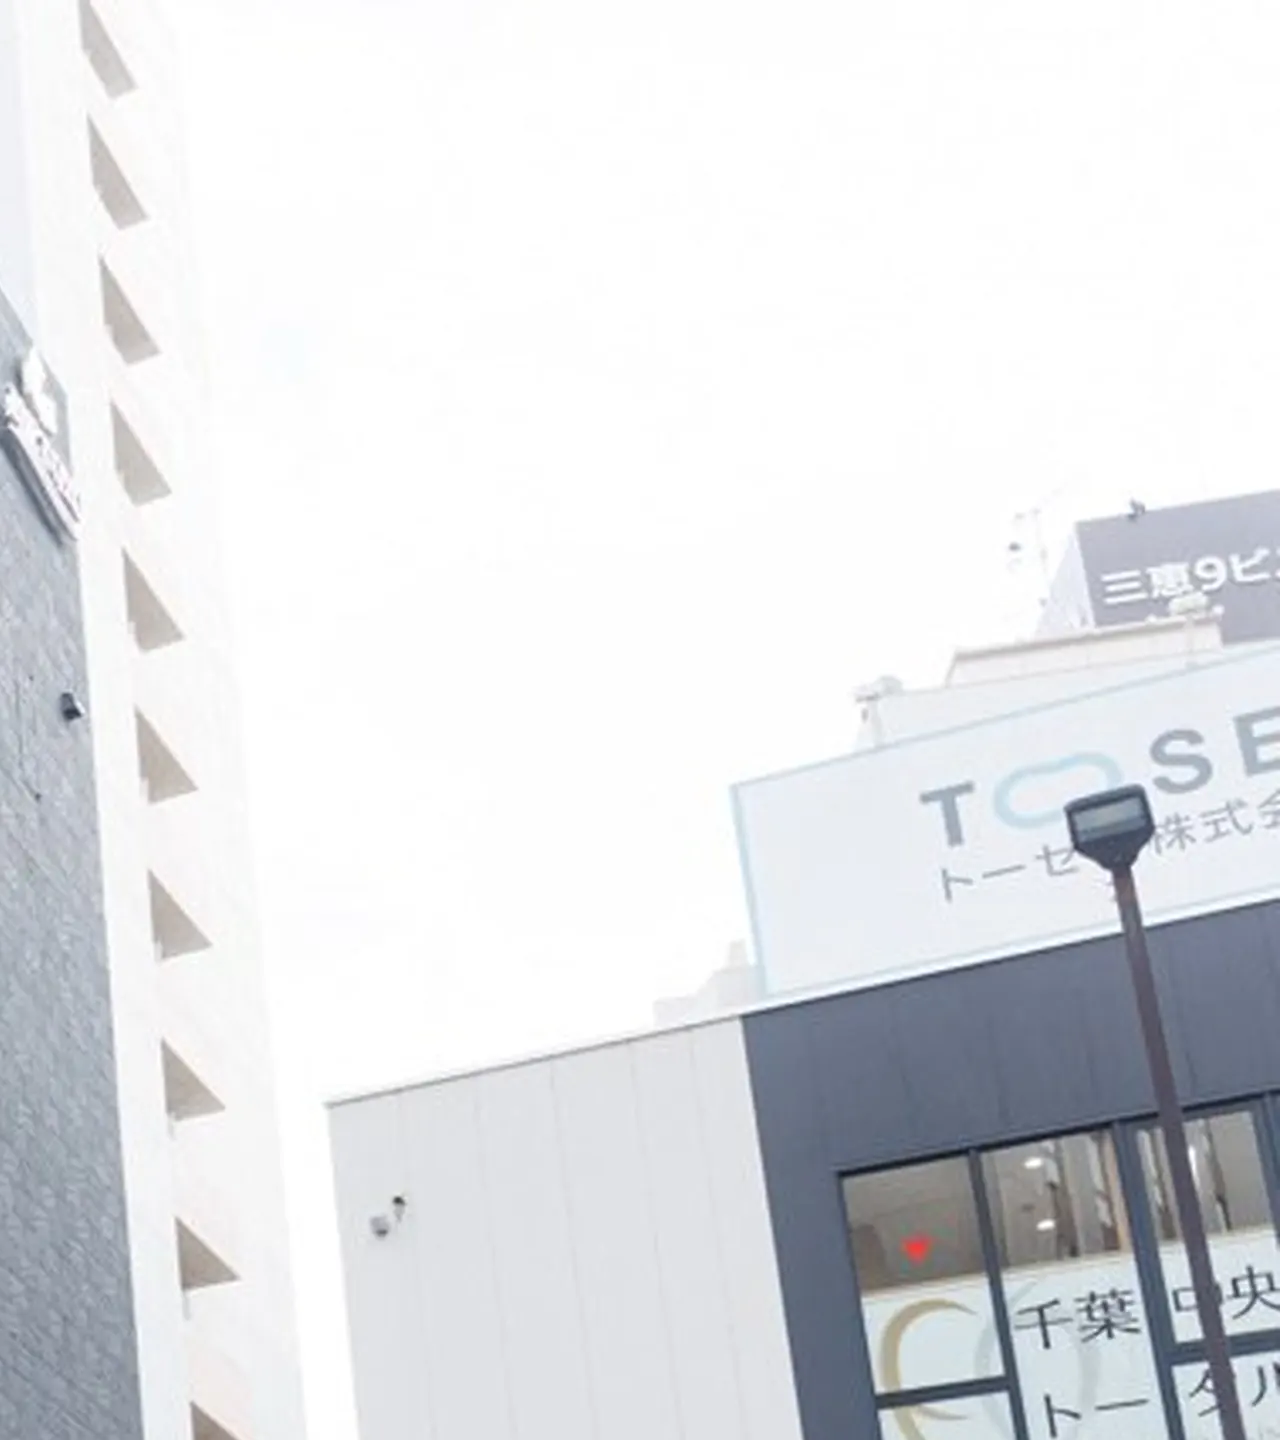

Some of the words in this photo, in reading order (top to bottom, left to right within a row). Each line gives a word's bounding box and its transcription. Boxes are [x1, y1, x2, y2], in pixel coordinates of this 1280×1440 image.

[1099, 548, 1280, 605] 三恵9ビ
[940, 790, 1280, 902] トーセ株式
